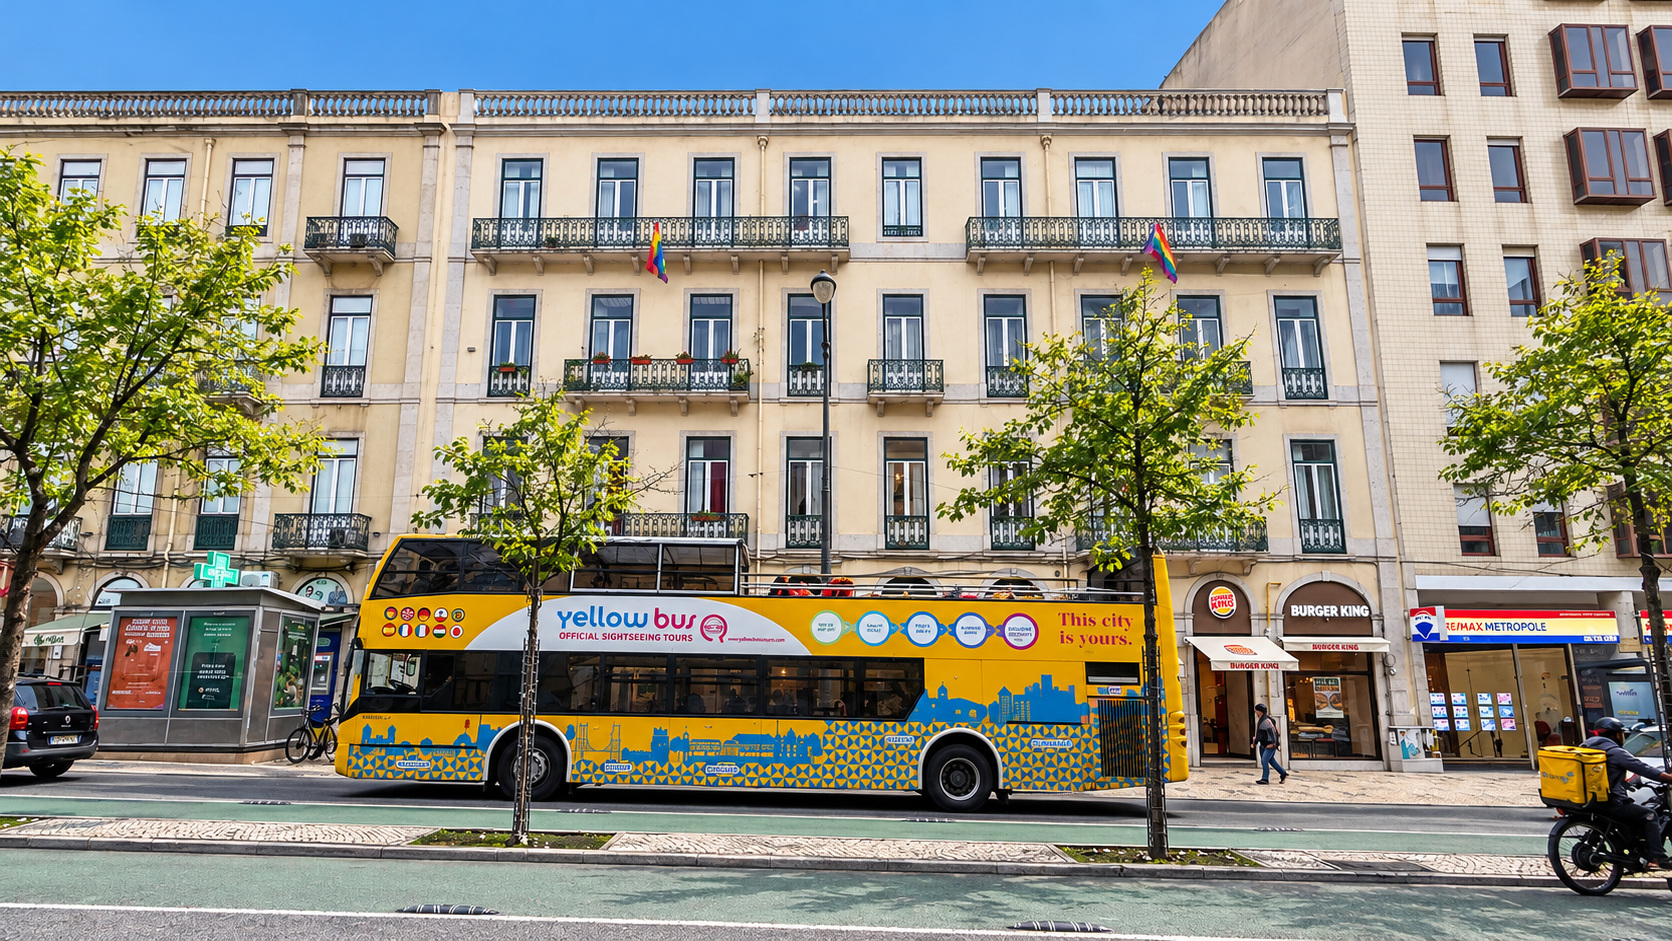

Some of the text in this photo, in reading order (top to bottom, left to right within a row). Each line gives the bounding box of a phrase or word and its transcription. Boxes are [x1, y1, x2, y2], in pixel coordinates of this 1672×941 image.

[557, 605, 697, 629] yellow bus
[1290, 605, 1370, 617] BURGER KING
[1058, 612, 1133, 631] This city
[1485, 622, 1547, 632] METROPOLE
[559, 632, 693, 642] OFFICIAL SIGHTSEEING TOURS
[1060, 631, 1132, 648] is yours.
